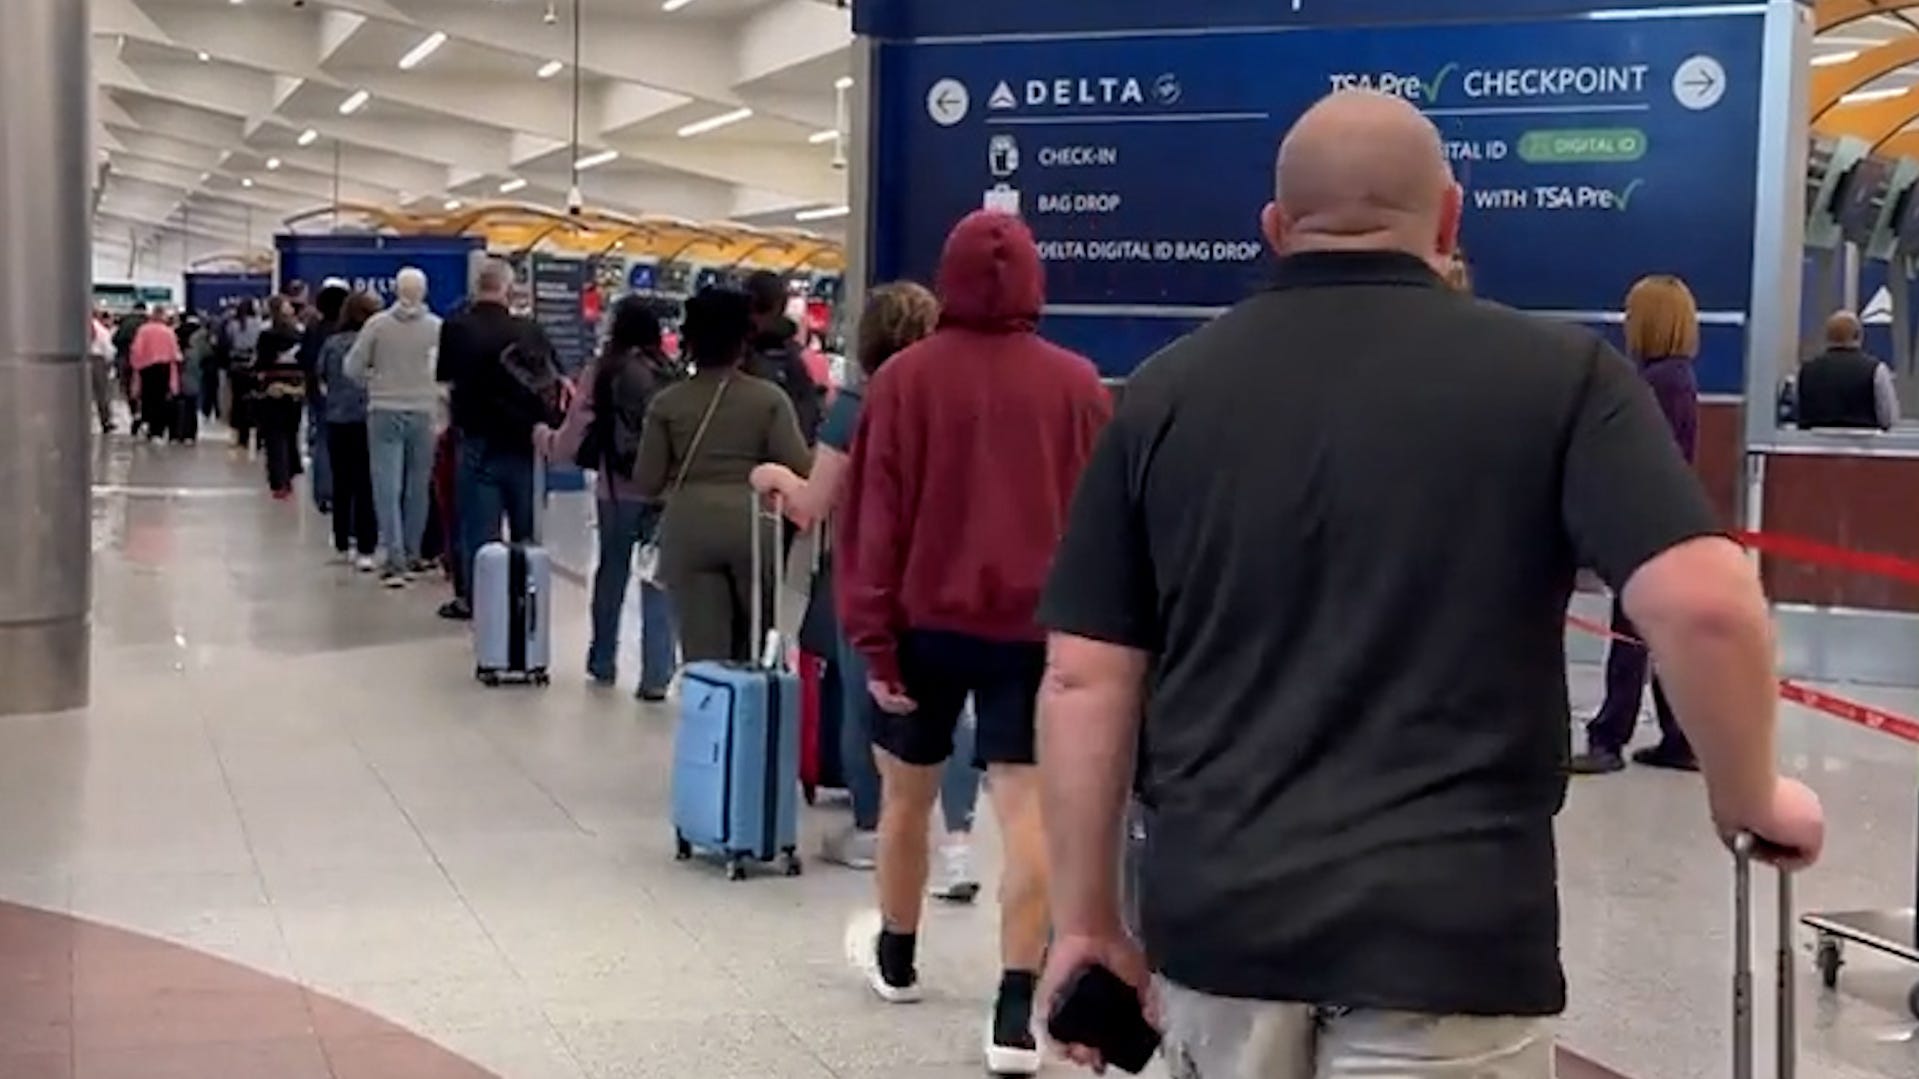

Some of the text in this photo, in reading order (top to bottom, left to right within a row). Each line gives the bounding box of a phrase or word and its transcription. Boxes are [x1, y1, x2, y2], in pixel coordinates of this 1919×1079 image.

[1463, 65, 1648, 97] CHECKPOINT
[1026, 78, 1143, 105] DELTA
[1486, 140, 1508, 158] ID
[1554, 137, 1636, 154] DIGITAL ID
[1038, 146, 1117, 167] CHECK-IN
[1038, 194, 1120, 213] BAG DROP
[1474, 186, 1613, 209] WITH TSA Pre
[1038, 240, 1262, 259] DELTA DIGITAL ID BAG DROP
